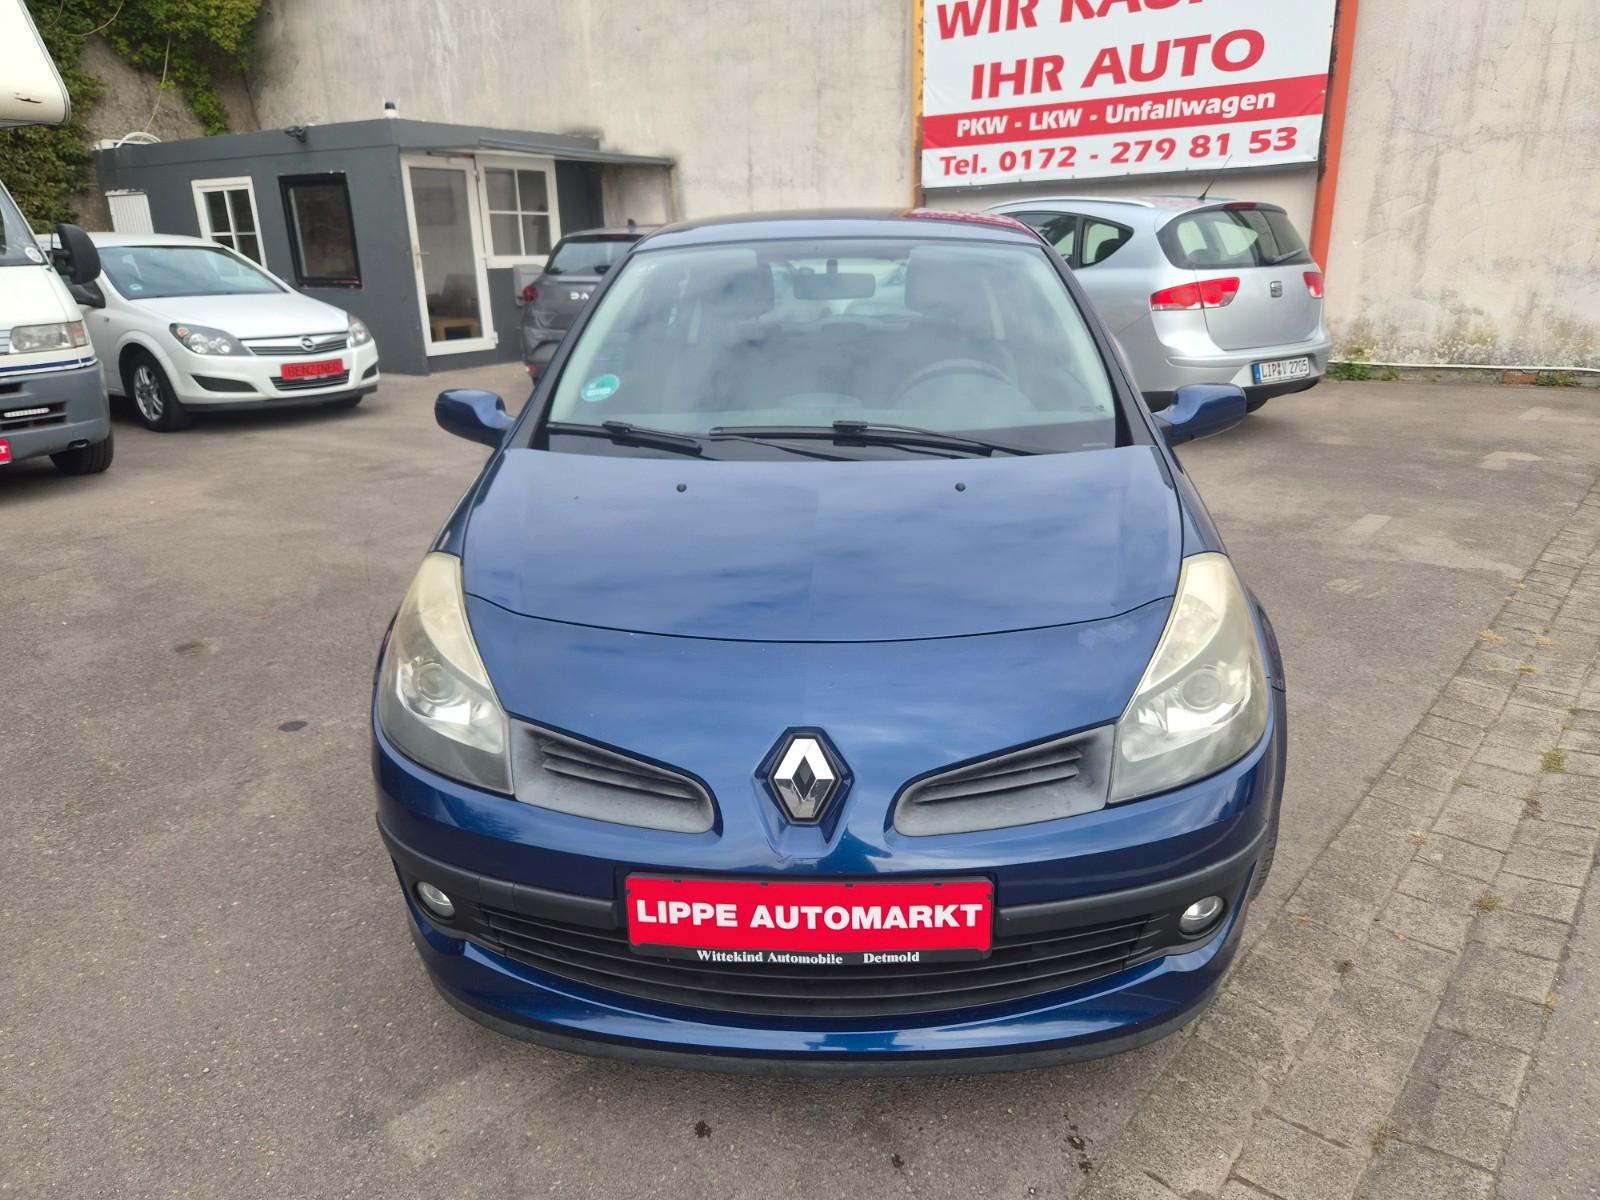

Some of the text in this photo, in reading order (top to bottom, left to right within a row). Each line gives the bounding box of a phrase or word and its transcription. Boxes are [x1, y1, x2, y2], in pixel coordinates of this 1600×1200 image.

[936, 0, 1039, 40] WIR
[971, 29, 1265, 100] IHR AUTO
[957, 115, 1008, 138] PKW
[1029, 108, 1083, 131] LKW
[1105, 92, 1276, 124] Unfallwagen
[939, 154, 988, 176] Tel.
[999, 146, 1078, 172] 0172
[1110, 138, 1177, 164] 279
[1188, 132, 1231, 158] 81
[1248, 126, 1298, 154] 53
[636, 899, 983, 930] LIPPE AUTOMARKT
[696, 950, 920, 965] Wittekind Automobile Detmold
